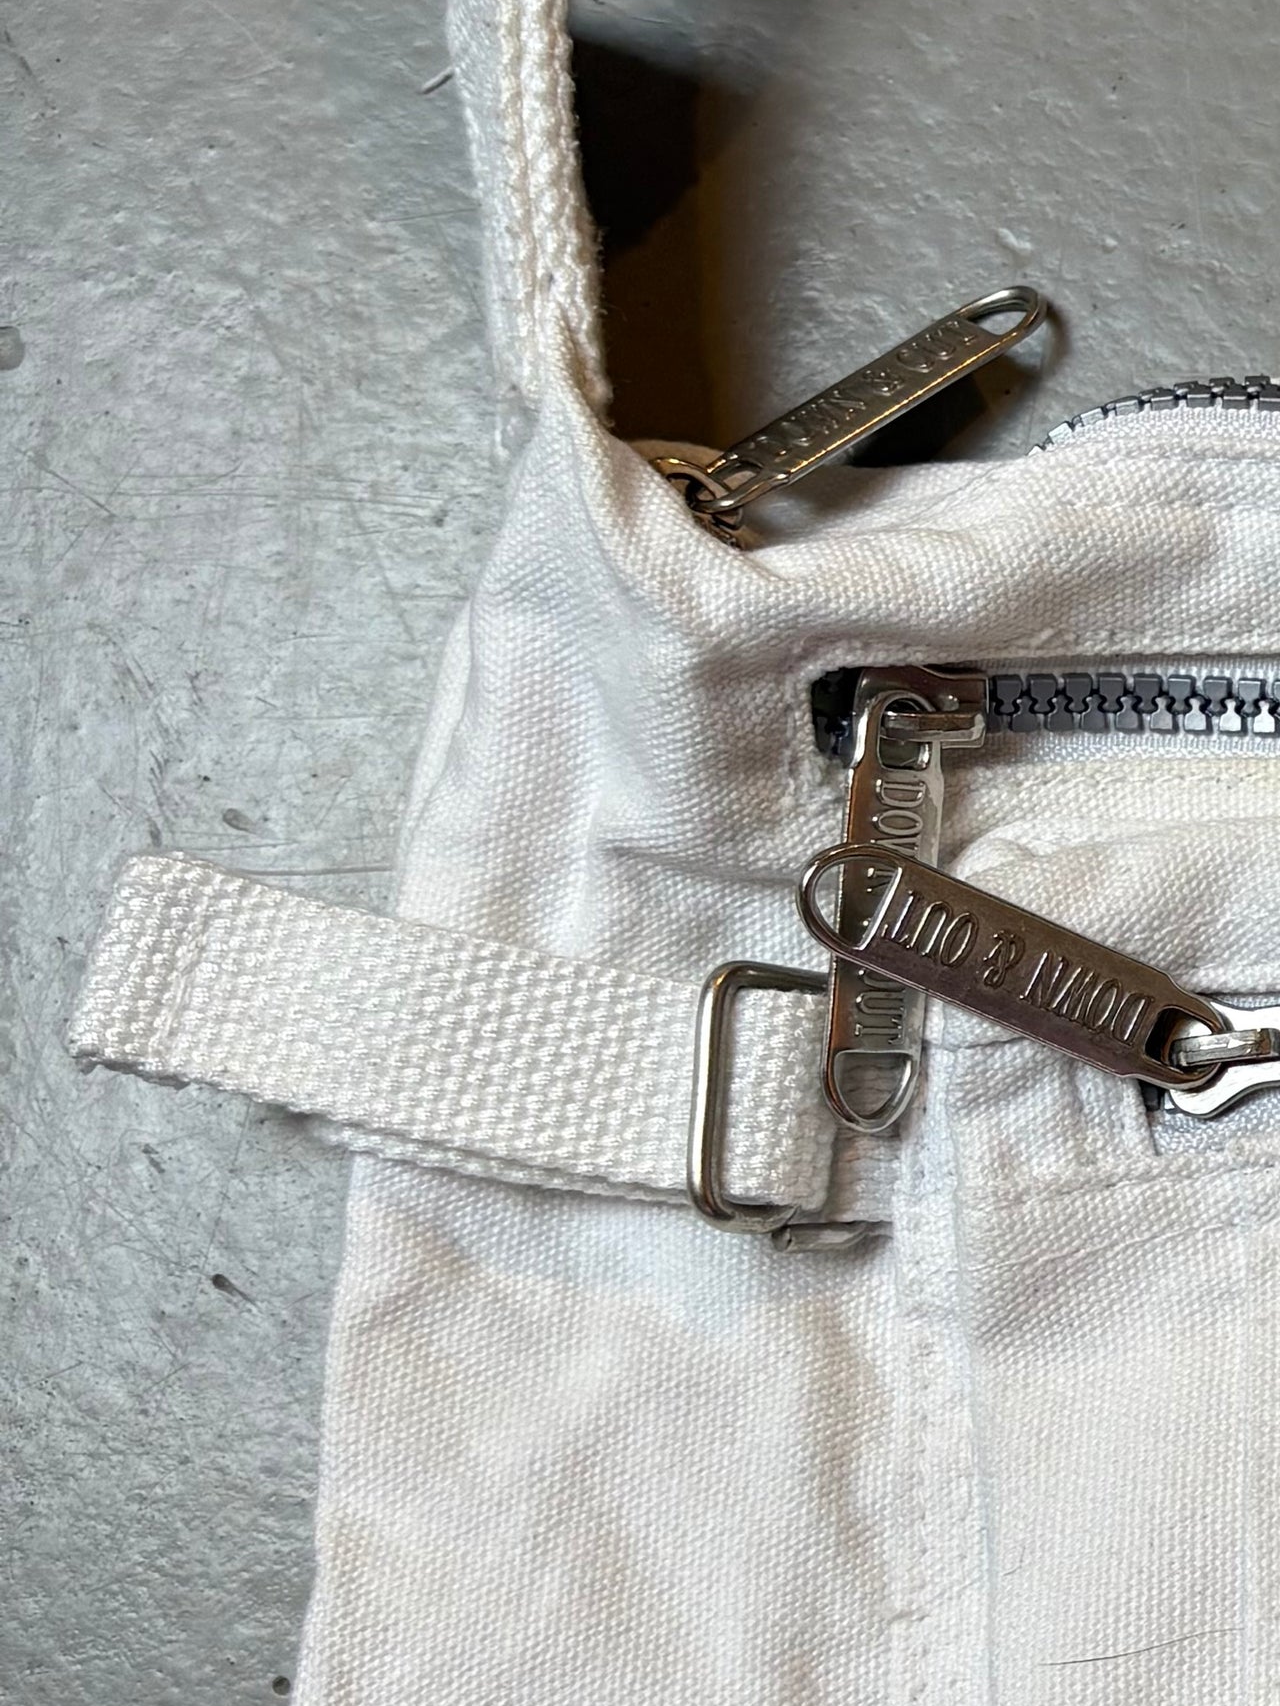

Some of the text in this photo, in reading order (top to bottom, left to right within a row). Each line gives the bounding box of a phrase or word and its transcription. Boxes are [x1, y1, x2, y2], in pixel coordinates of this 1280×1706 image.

[748, 320, 976, 462] DOWN & OUT
[882, 890, 1156, 1047] DOWN & OUT
